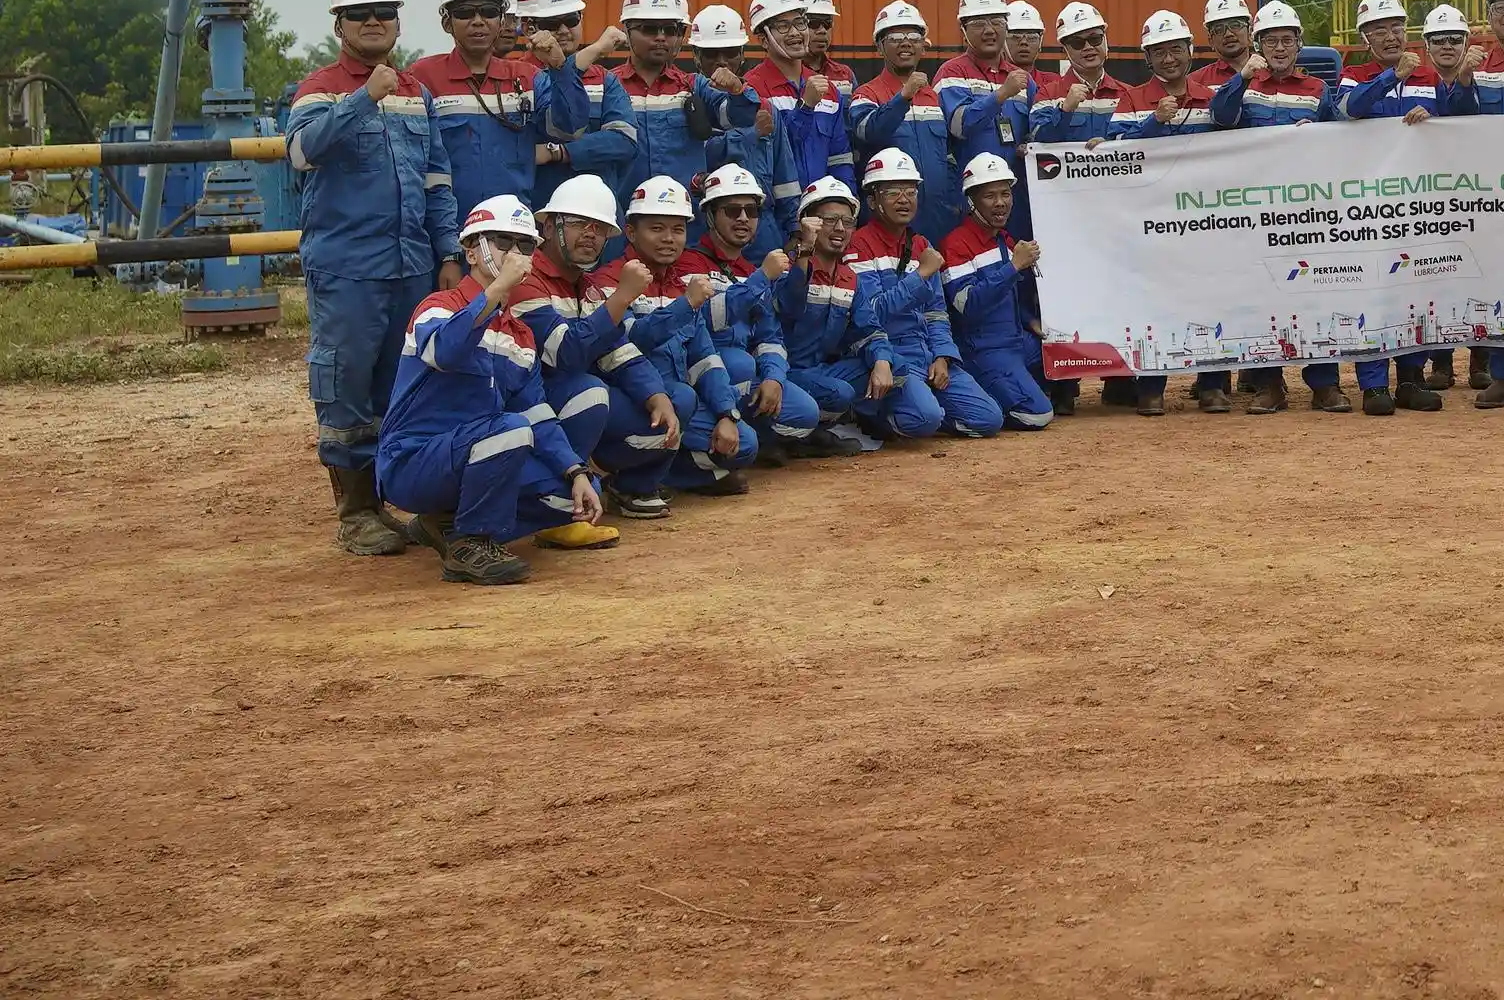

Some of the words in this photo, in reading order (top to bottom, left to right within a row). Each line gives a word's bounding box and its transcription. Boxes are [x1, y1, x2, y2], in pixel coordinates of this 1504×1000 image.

[1064, 150, 1145, 163] Danantara
[1066, 163, 1142, 178] Indonesia
[1175, 182, 1332, 210] INJECTION
[1340, 173, 1493, 199] CHEMICAL
[1143, 214, 1257, 236] Penyediaan,
[1260, 207, 1343, 227] Blending,
[1347, 203, 1406, 221] QA/QC
[1409, 199, 1445, 216] Slug
[1268, 231, 1325, 247] Balam
[1329, 225, 1378, 242] South
[1382, 224, 1410, 240] SSF
[1413, 218, 1475, 236] Stage-1
[1414, 254, 1463, 267] PERTAMINA
[1313, 265, 1363, 275] PERTAMINA
[1414, 265, 1457, 277] LUBRICANTS
[1313, 276, 1334, 284] HULU
[1335, 275, 1362, 283] ROKAN
[1053, 358, 1113, 368] pertamina.com
